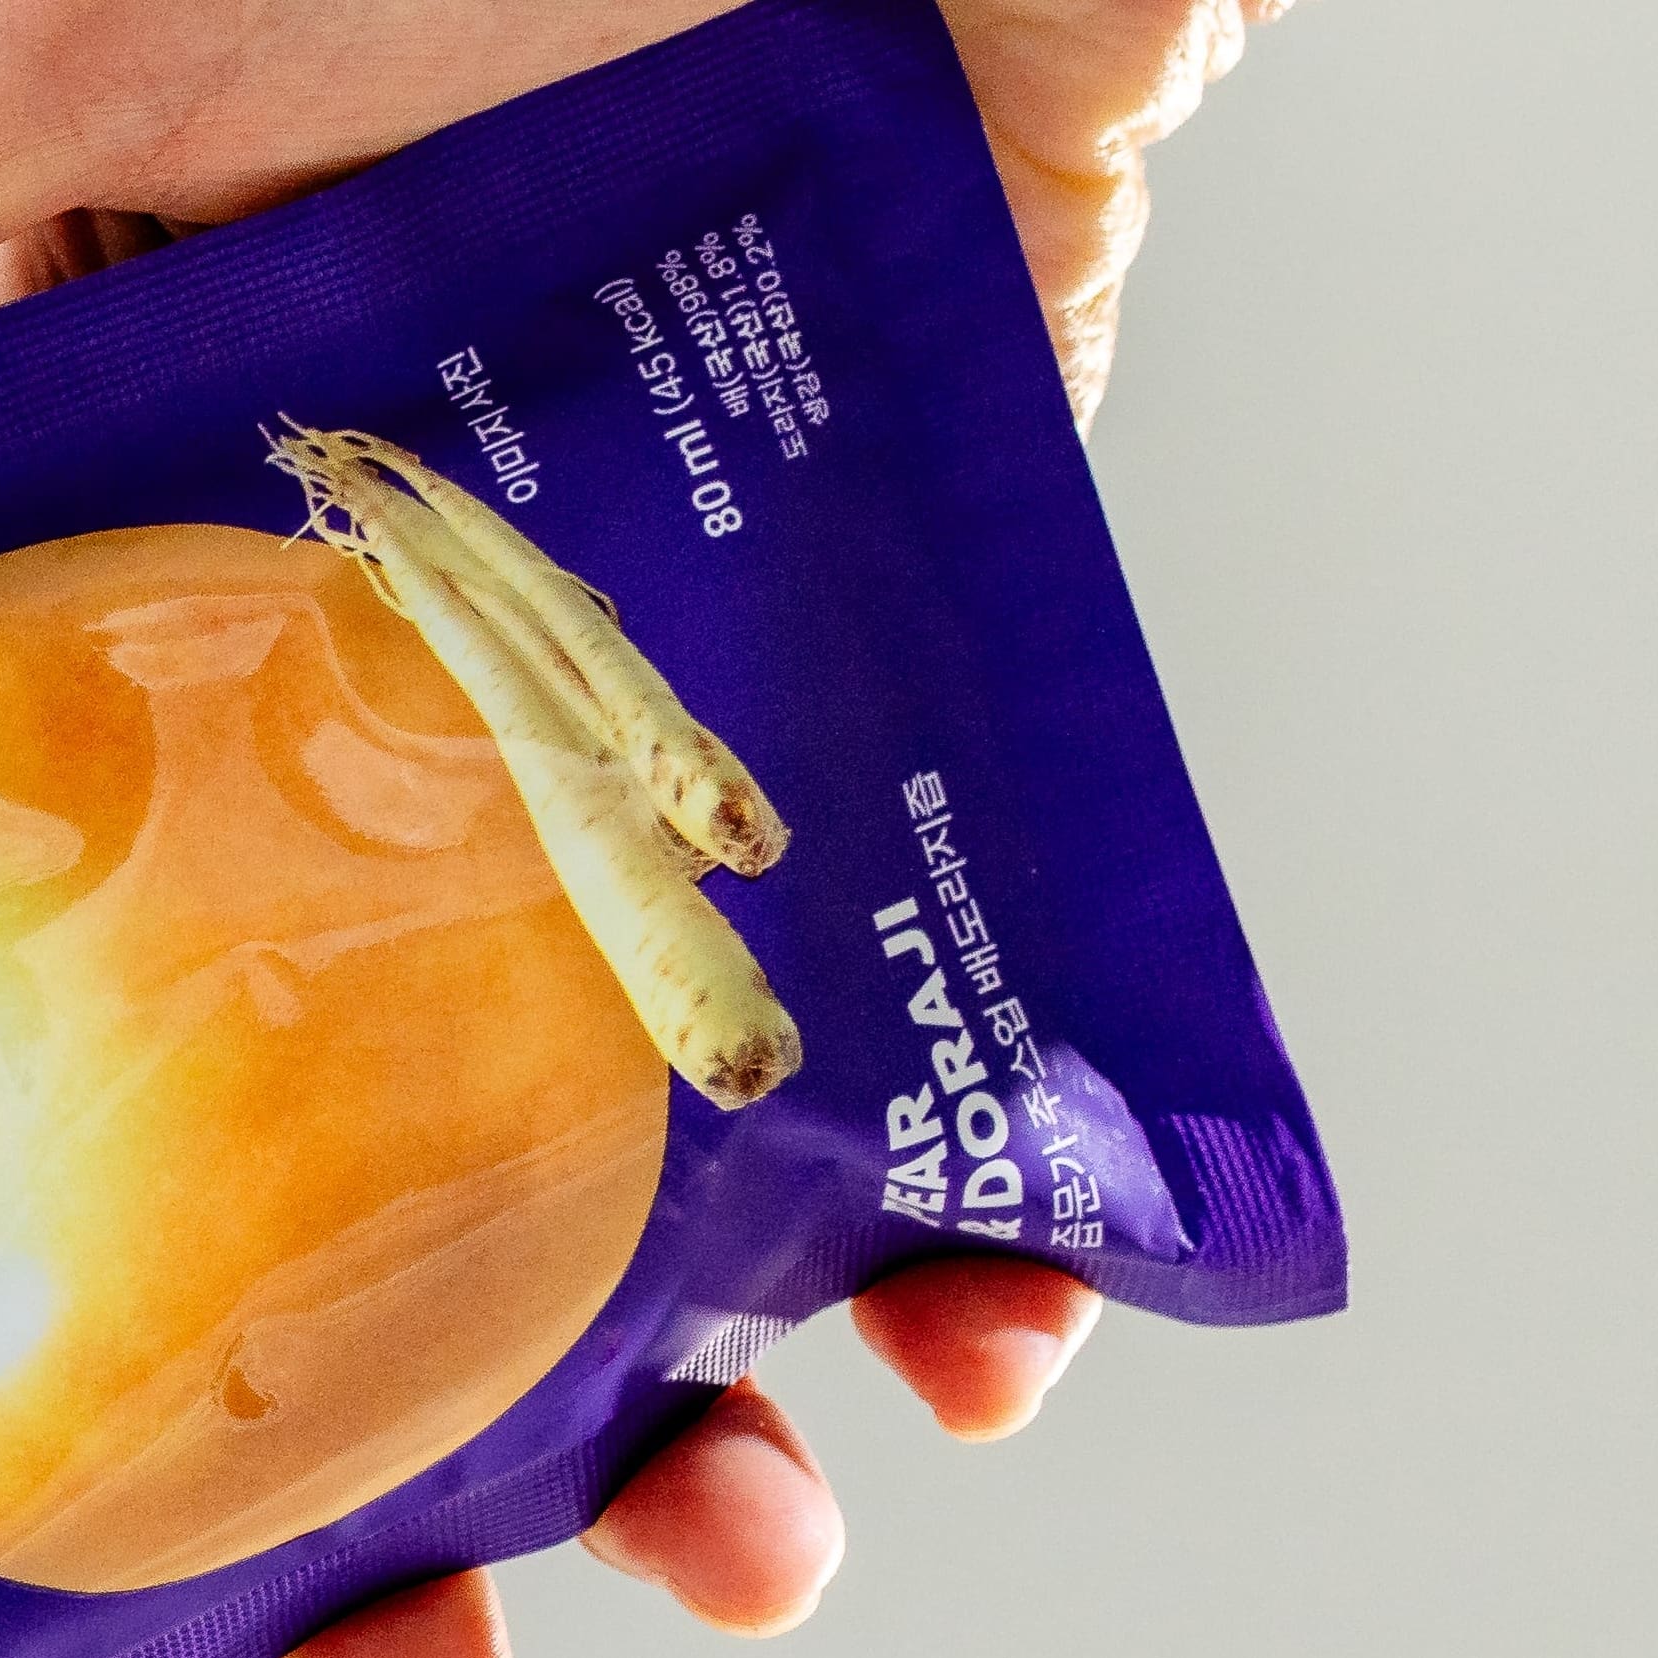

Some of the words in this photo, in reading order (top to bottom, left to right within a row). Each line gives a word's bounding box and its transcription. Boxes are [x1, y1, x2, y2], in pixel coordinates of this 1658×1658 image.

[593, 277, 665, 354] kcal)
[638, 352, 697, 416] (45
[663, 418, 721, 477] ml
[691, 480, 745, 539] 80
[901, 770, 1003, 996] 배도라지즙
[982, 996, 1064, 1129] 주스업
